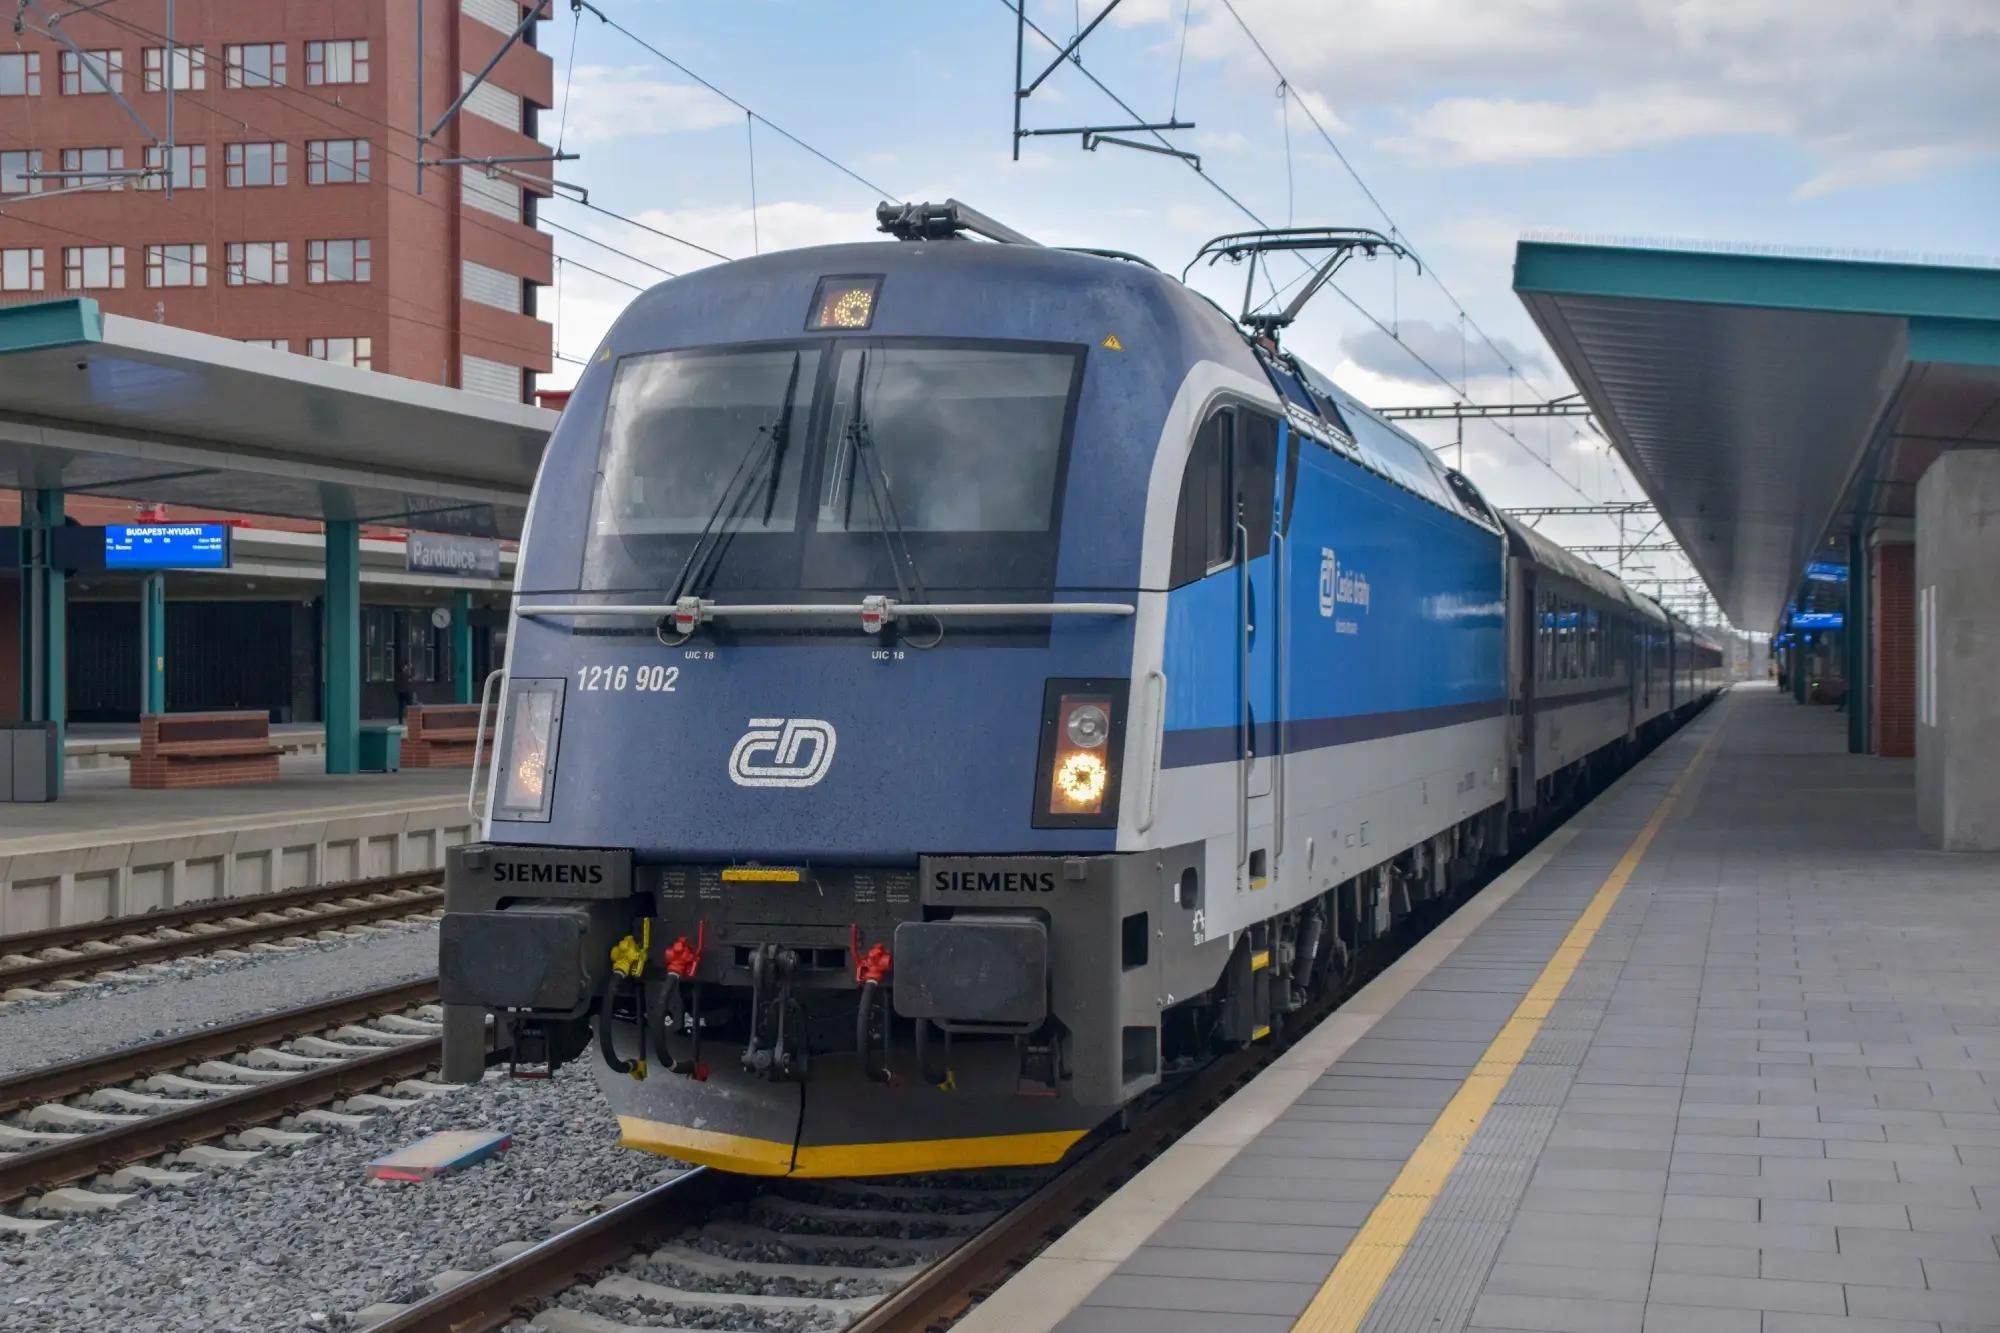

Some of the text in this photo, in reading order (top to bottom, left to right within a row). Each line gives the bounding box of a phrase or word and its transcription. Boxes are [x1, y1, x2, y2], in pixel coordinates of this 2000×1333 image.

[126, 528, 202, 536] BUDAPEST-NYUGATI
[413, 541, 476, 569] Pardubice
[684, 651, 714, 660] UIC 18
[871, 650, 905, 660] UIC 18
[577, 665, 680, 692] 1216 902
[494, 862, 603, 884] SIEMENS
[935, 871, 1055, 892] SIEMENS
